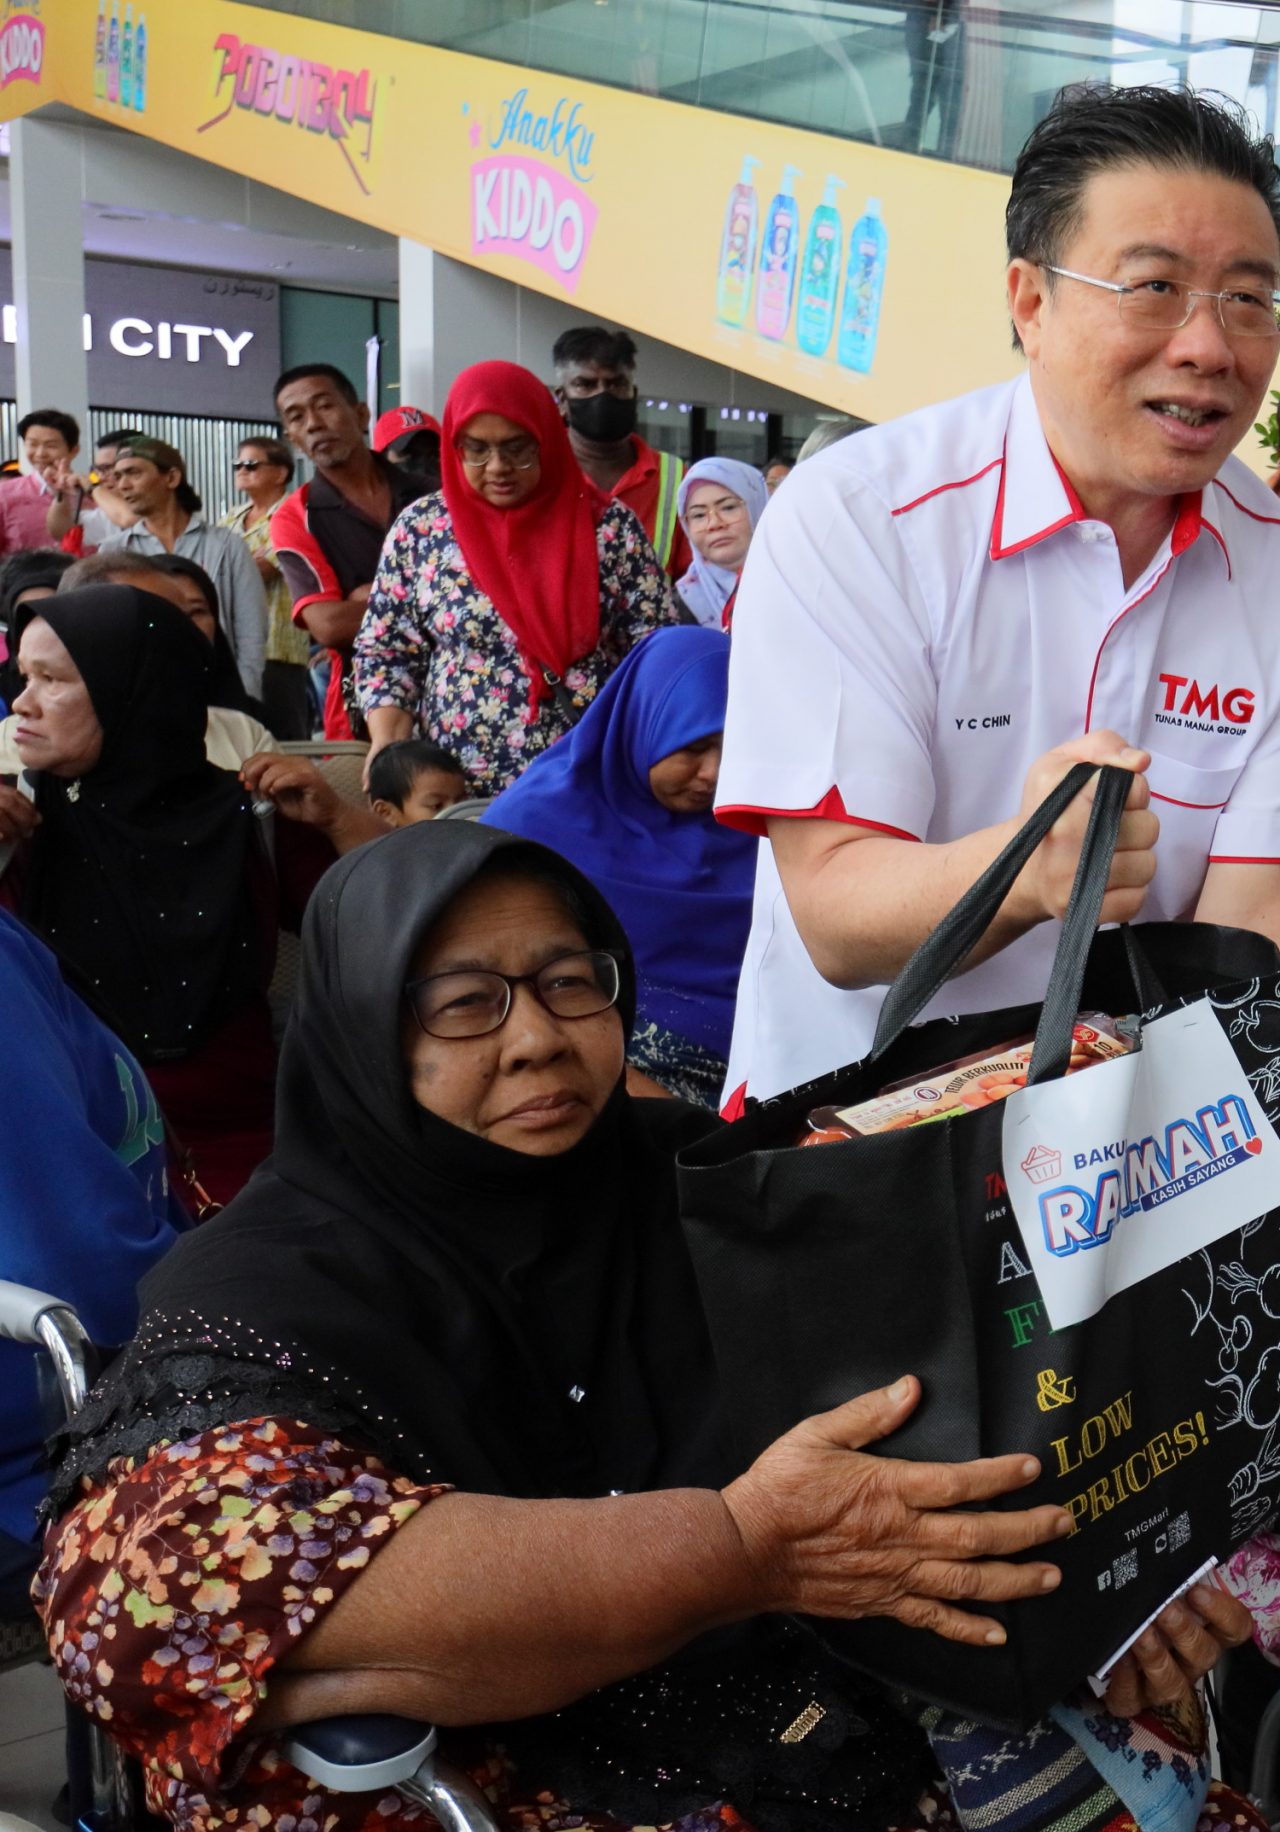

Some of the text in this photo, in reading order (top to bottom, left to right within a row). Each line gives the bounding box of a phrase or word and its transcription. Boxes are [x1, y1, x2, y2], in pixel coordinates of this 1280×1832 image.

[489, 87, 596, 182] Anakku
[474, 167, 585, 273] KIDDO
[109, 317, 254, 367] CITY
[956, 714, 1011, 730] Y C CHIN
[1158, 673, 1256, 724] TMG
[1154, 713, 1247, 737] TUNAS MANJA GROUP
[945, 1061, 1025, 1094] TELUR BERKUALITI
[1073, 1139, 1127, 1170] BAKU
[1151, 1154, 1236, 1205] KASIH SAYANG
[1036, 1369, 1077, 1412] &
[1050, 1391, 1134, 1478] LOW
[1064, 1411, 1210, 1540] PRICES!
